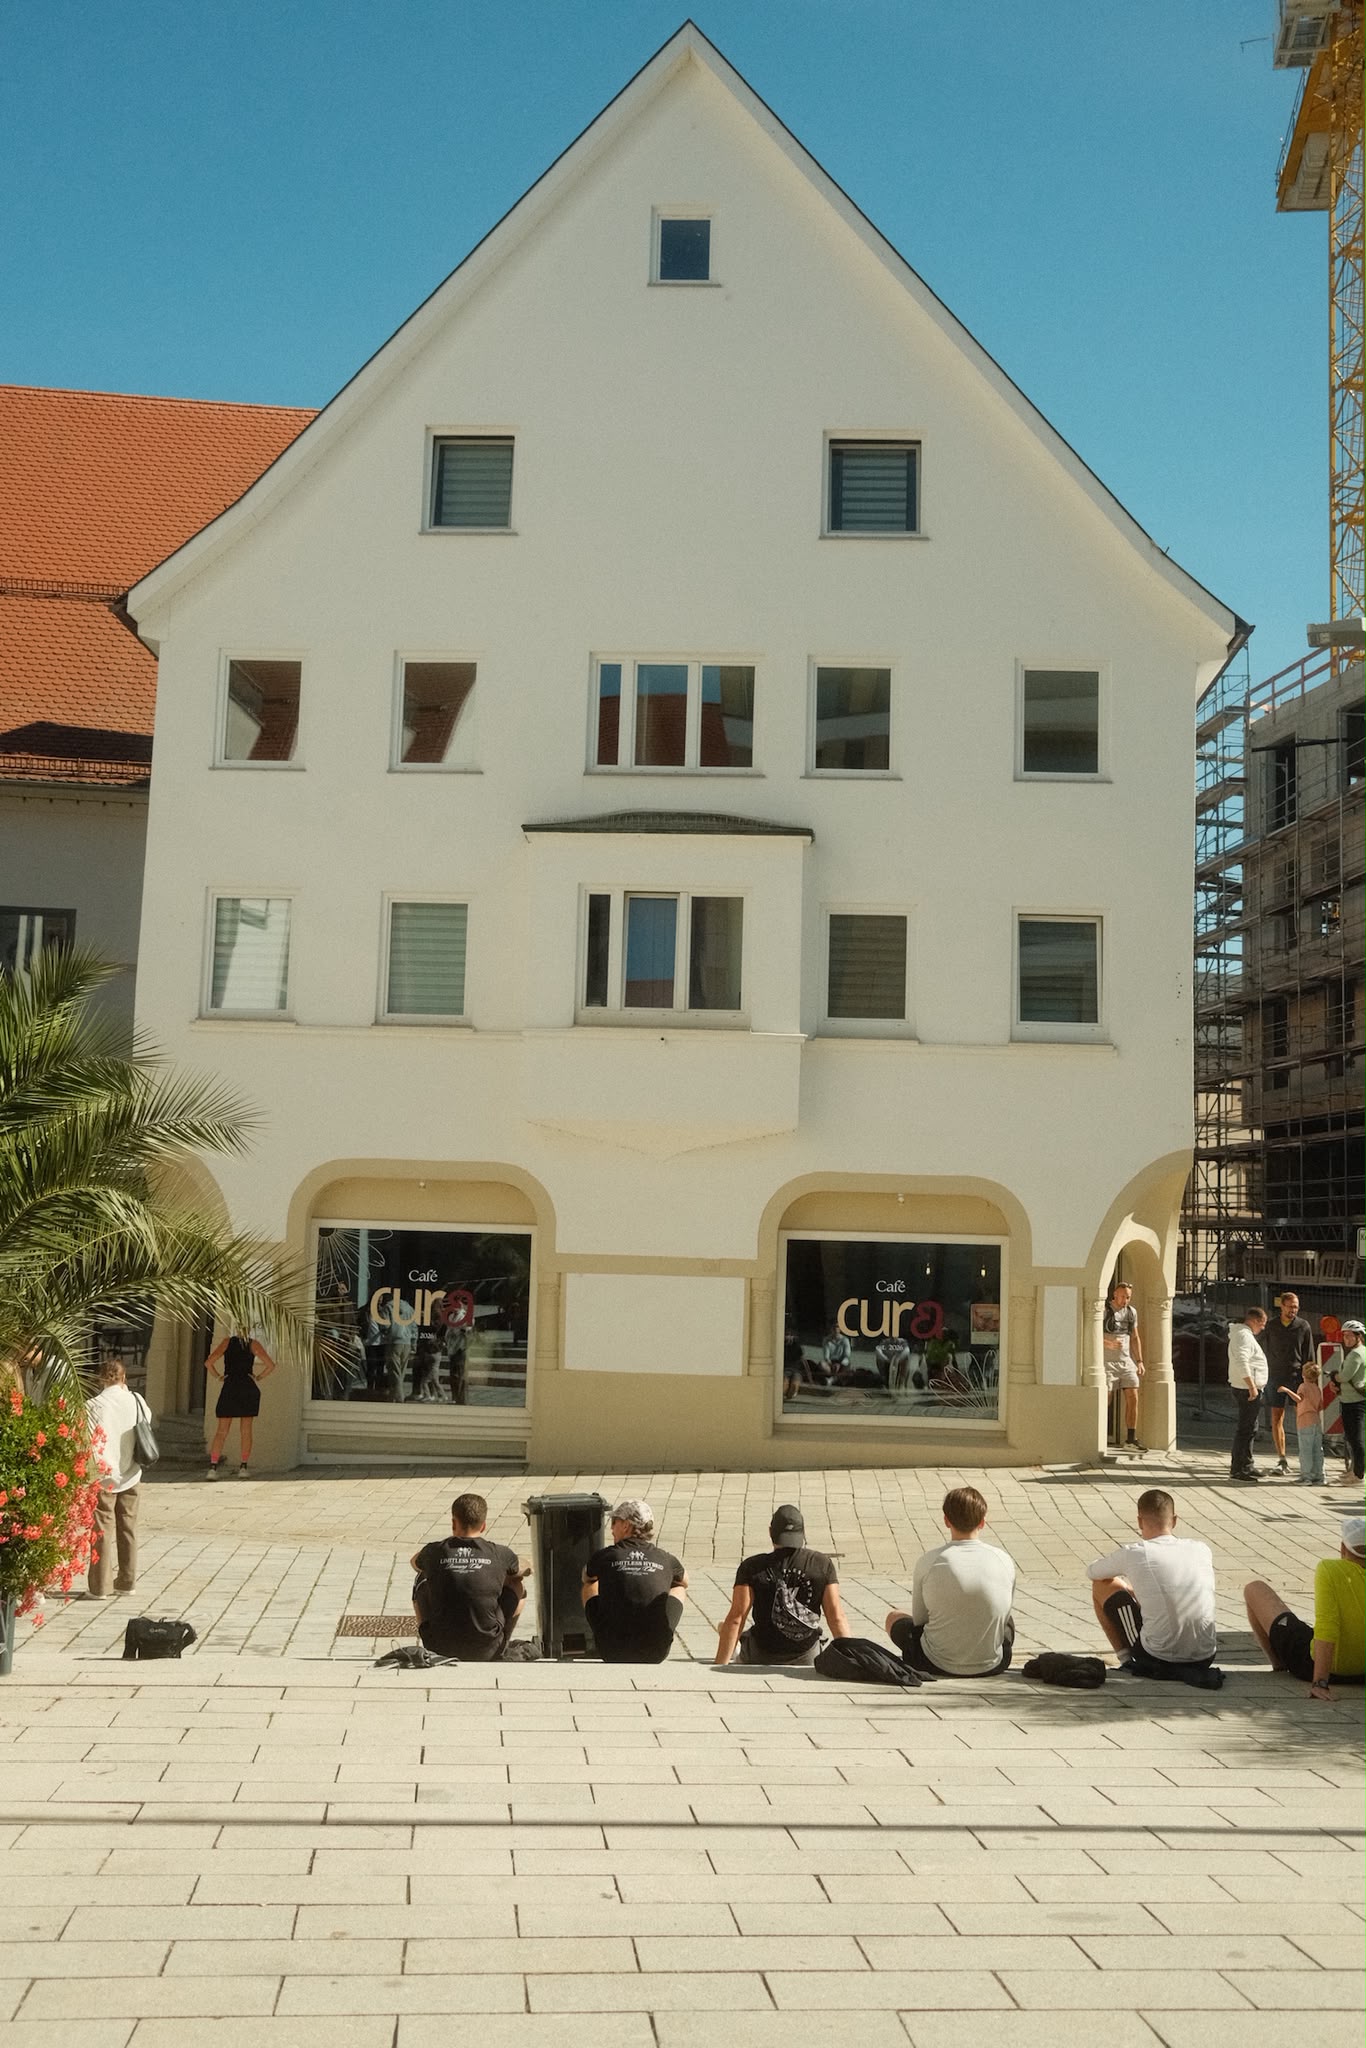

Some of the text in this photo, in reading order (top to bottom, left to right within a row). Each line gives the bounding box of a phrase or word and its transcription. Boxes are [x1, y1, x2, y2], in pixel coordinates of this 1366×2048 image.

[408, 1269, 438, 1282] Café
[876, 1280, 906, 1293] Café
[370, 1287, 474, 1328] cura
[837, 1297, 944, 1339] cura
